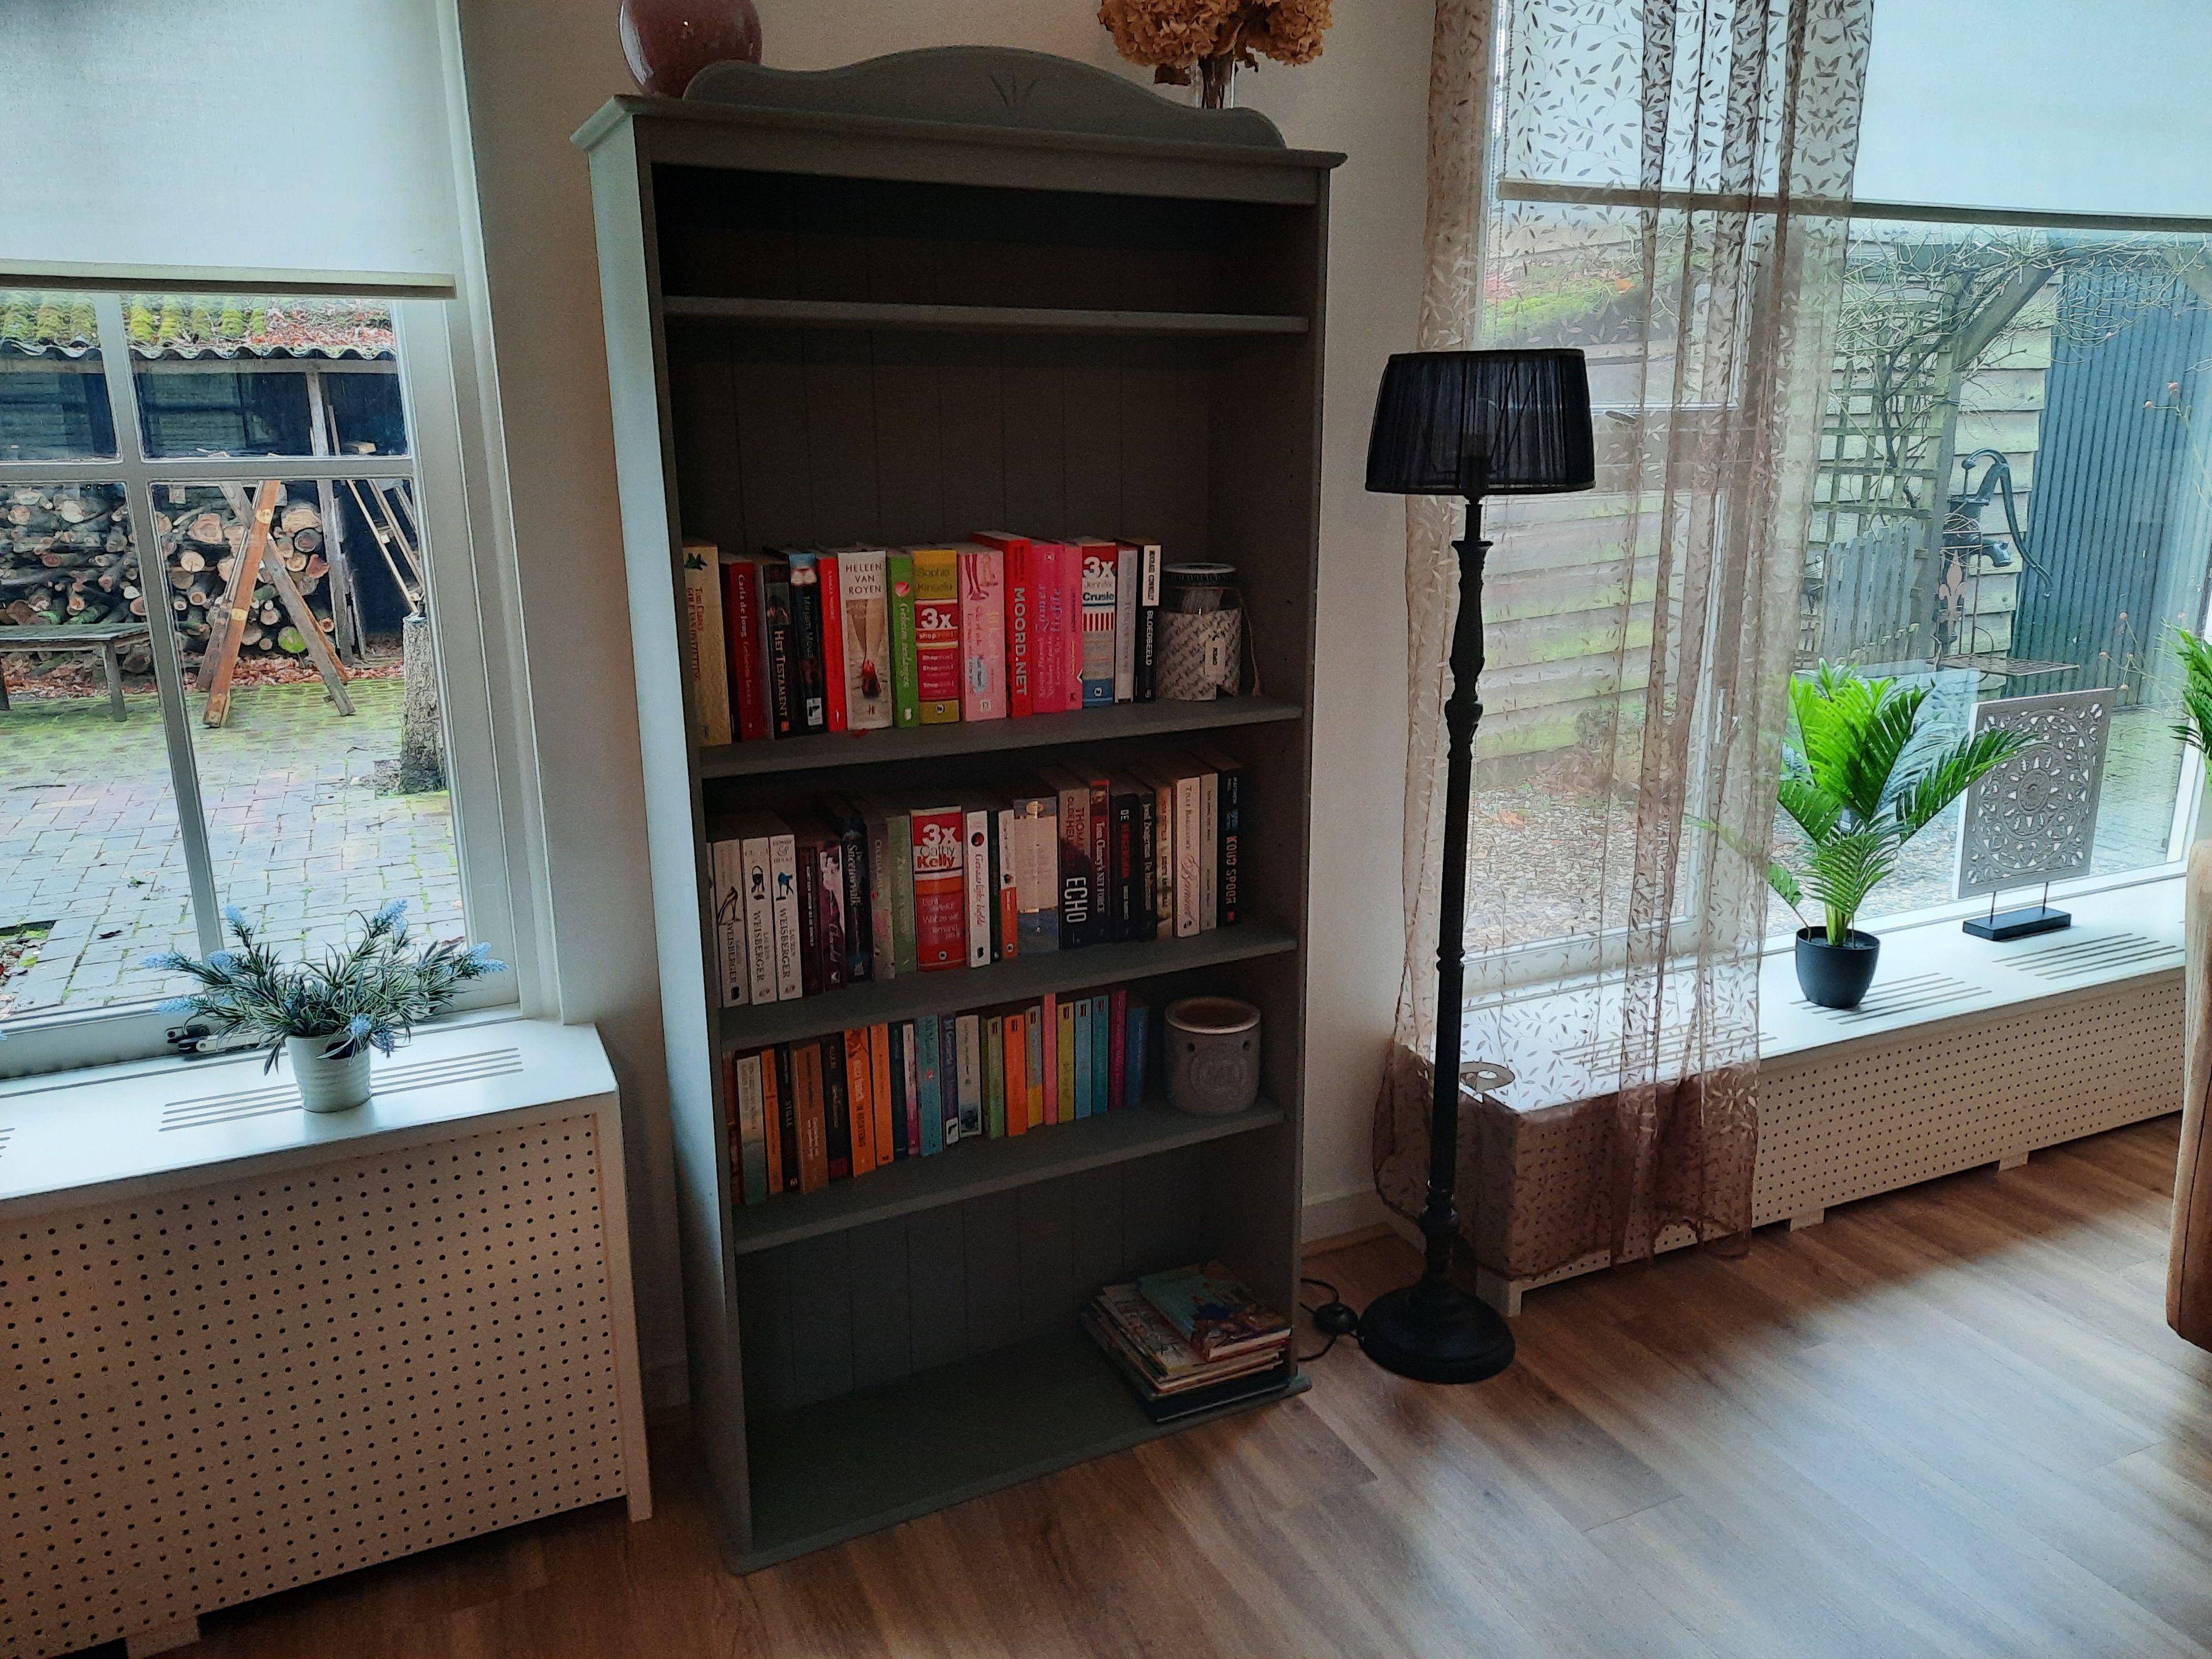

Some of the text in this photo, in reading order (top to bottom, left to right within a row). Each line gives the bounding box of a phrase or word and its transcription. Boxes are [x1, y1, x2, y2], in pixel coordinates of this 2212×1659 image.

[845, 563, 882, 573] HELEEN
[1082, 556, 1115, 578] 3x
[738, 573, 747, 600] Carla
[849, 585, 881, 594] ROYEN
[854, 574, 875, 584] VAN
[740, 602, 747, 613] de
[1082, 592, 1114, 601] Crusie
[695, 587, 704, 631] Tom Clancy
[921, 608, 953, 630] 3x
[1013, 586, 1028, 696] MOORD.NET
[1145, 609, 1154, 667] BLOEDBEELD
[774, 629, 788, 717] HET TESTAMENT
[1120, 809, 1130, 821] DE
[922, 823, 957, 845] 3x
[917, 854, 955, 869] Kelly
[920, 844, 955, 858] Cathy
[1225, 835, 1238, 867] KOUD
[1064, 876, 1089, 924] ECHO
[726, 922, 738, 984] WEISBERGER
[753, 911, 766, 982] WEISBERGER
[779, 907, 790, 979] WEISBERGER
